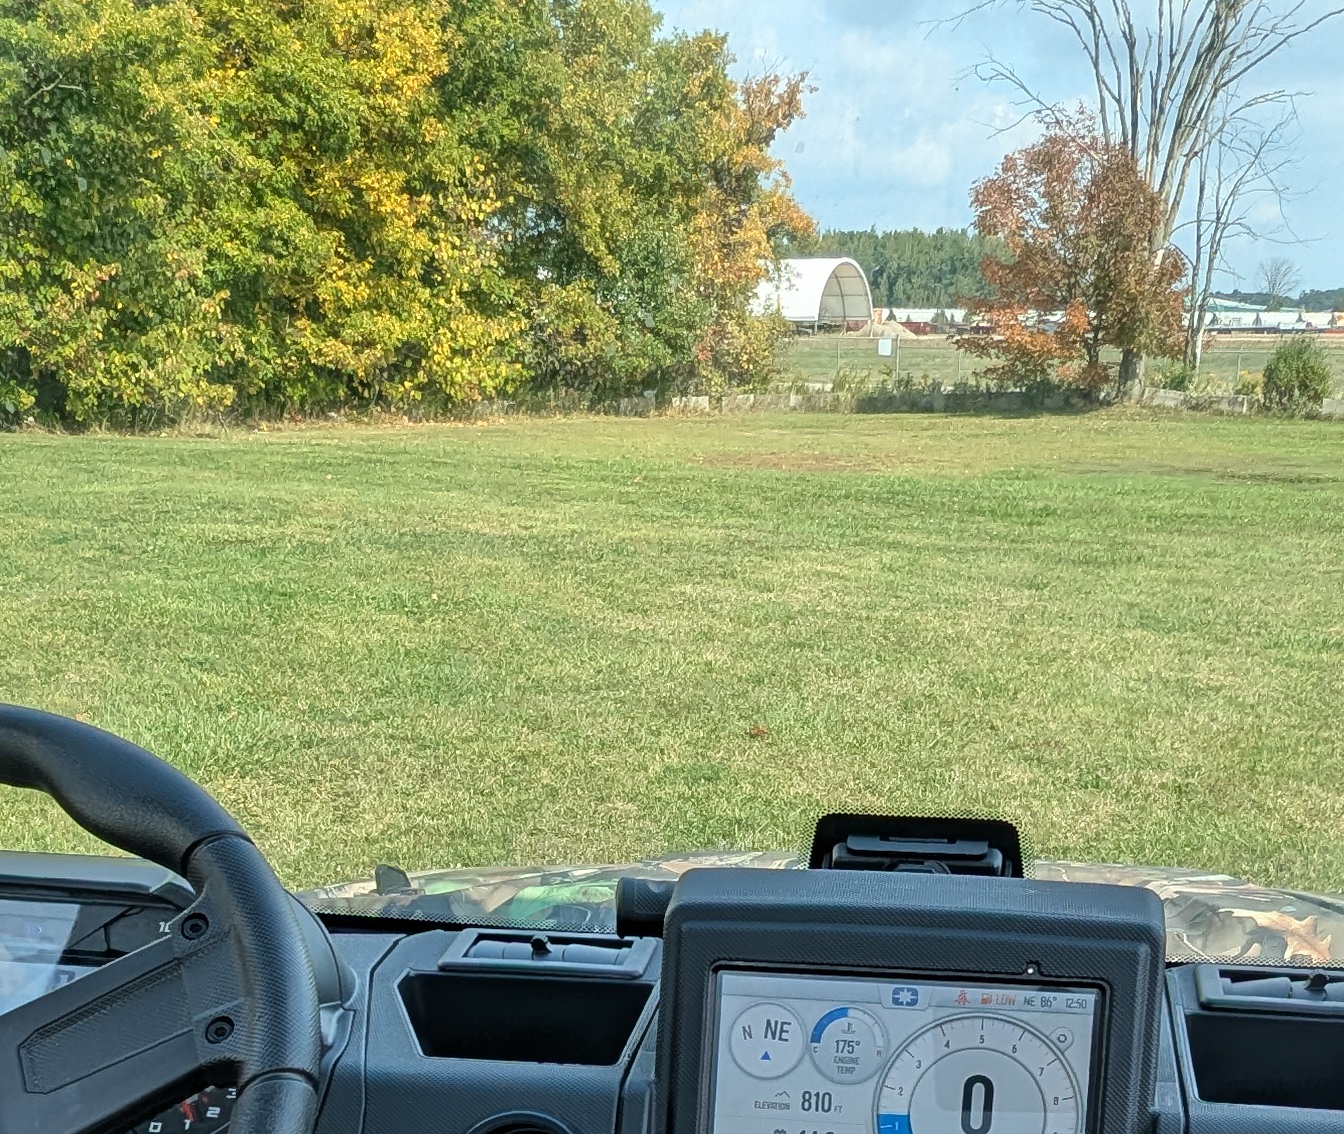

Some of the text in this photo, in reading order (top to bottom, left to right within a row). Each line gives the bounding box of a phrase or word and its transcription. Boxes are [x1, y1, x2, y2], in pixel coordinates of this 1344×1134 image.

[996, 993, 1016, 1006] LOW
[742, 1024, 753, 1041] N
[764, 1019, 792, 1042] NE
[979, 1034, 985, 1044] 5
[943, 1040, 950, 1050] 4
[1011, 1044, 1018, 1054] 6
[833, 1056, 860, 1066] ENGINE
[915, 1060, 922, 1070] 3
[836, 1065, 856, 1075] TEMP
[1038, 1066, 1045, 1077] 7
[898, 1087, 904, 1097] 2
[754, 1090, 843, 1114] ELEVATION 810 FT
[206, 1106, 221, 1118] 2
[148, 1121, 163, 1133] 0
